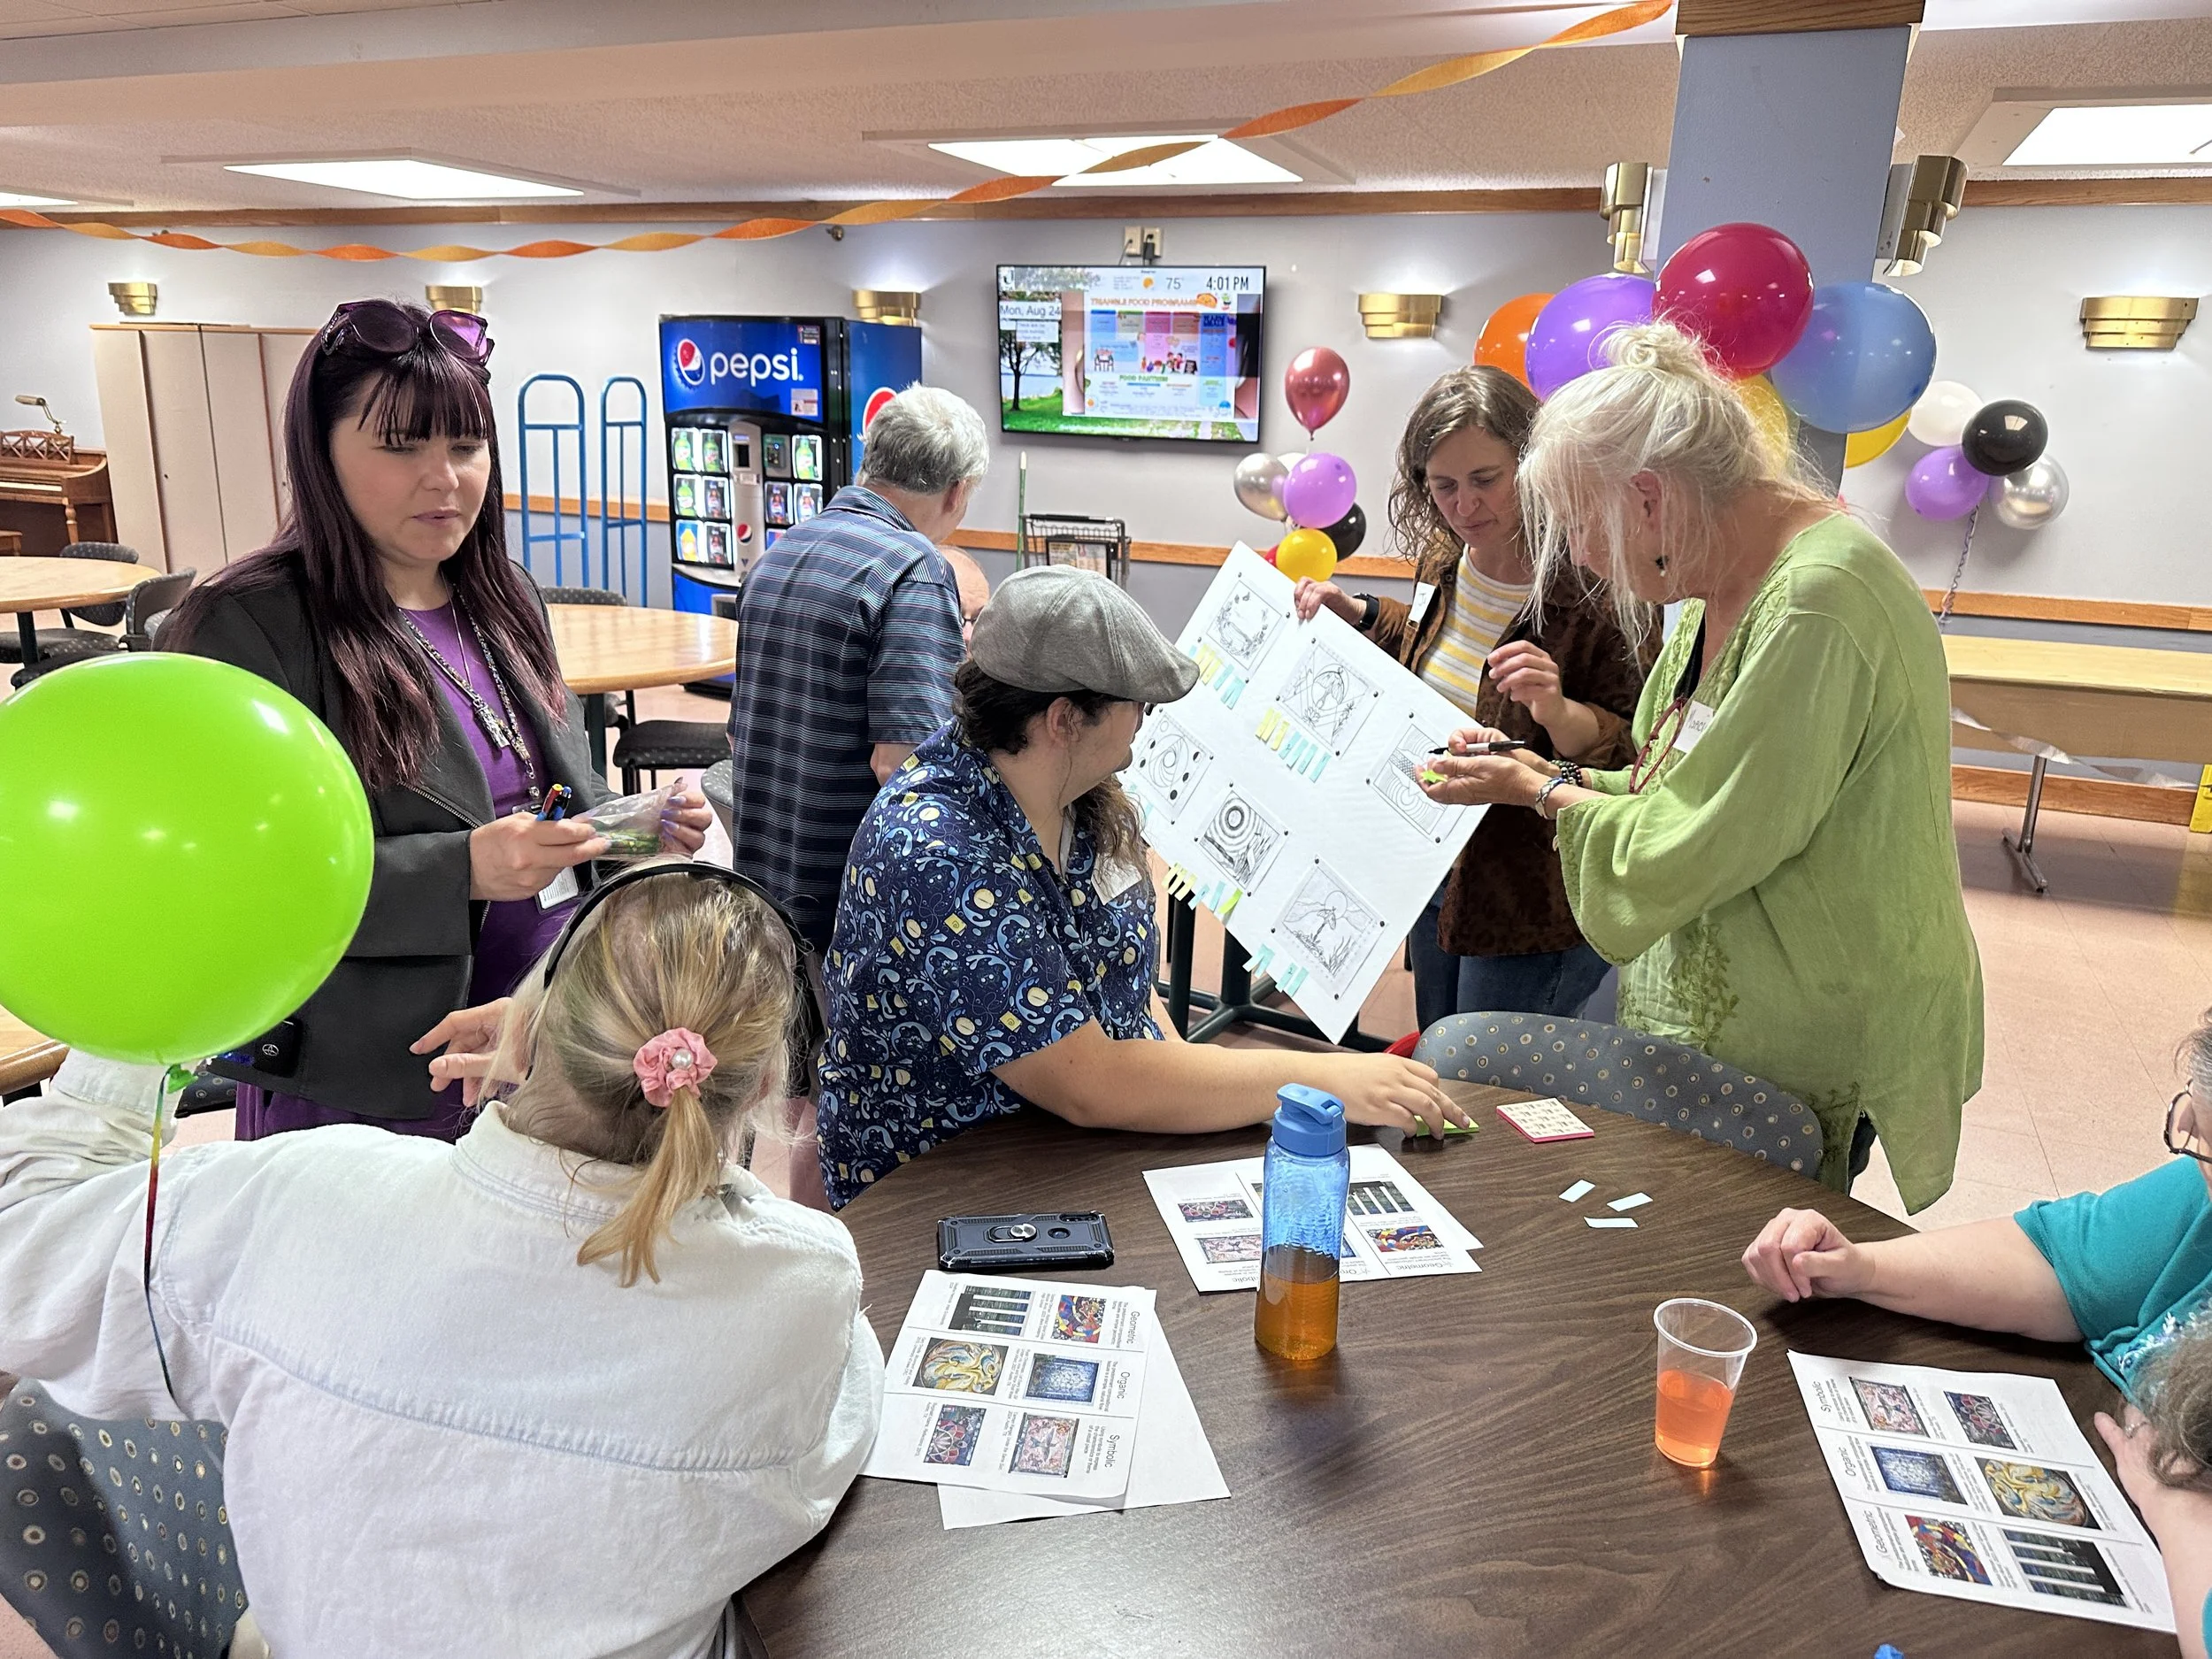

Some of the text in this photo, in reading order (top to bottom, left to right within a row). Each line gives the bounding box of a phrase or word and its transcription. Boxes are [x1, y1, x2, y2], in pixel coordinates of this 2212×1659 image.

[1206, 276, 1249, 291] 4:01 PM
[1000, 305, 1061, 318] Mon, Aug 24
[710, 347, 798, 388] pepsi
[1125, 1310, 1141, 1344] Geometric
[1114, 1371, 1131, 1399] Organic
[1812, 1380, 1832, 1413] Symbolic
[1103, 1433, 1121, 1468] Symbolic
[1836, 1446, 1857, 1478] Organic
[1863, 1509, 1886, 1555] Geometric
